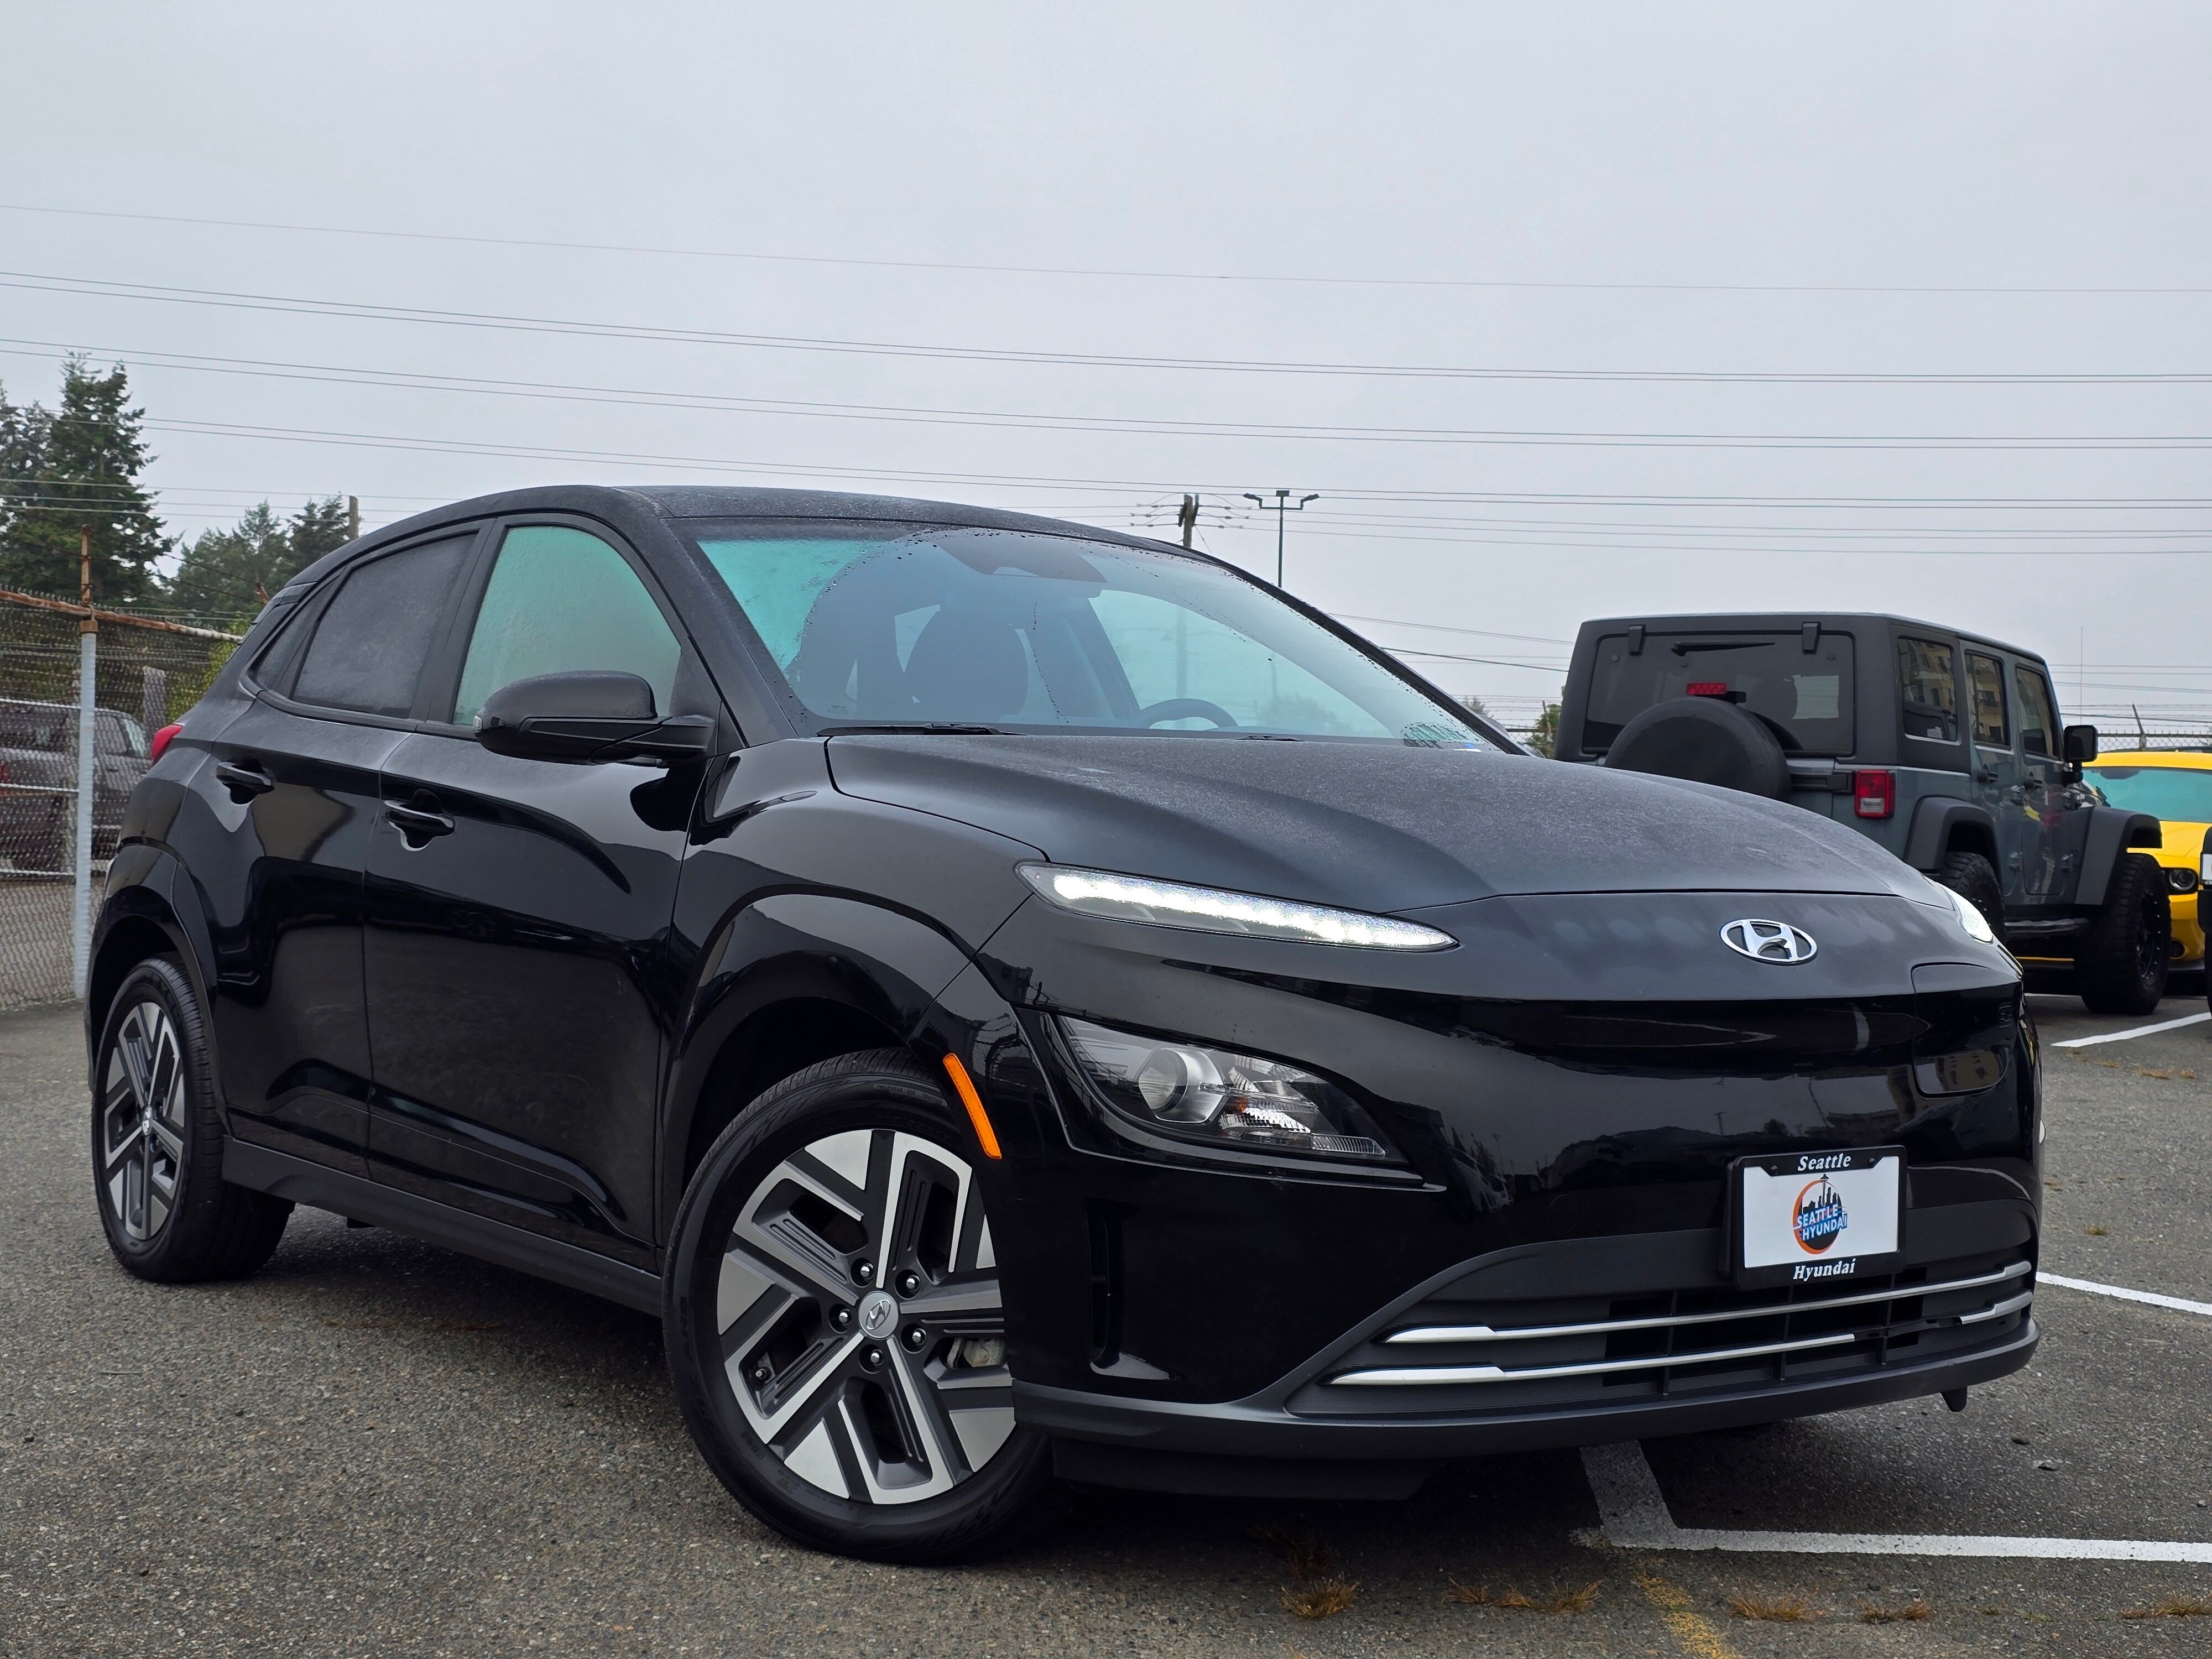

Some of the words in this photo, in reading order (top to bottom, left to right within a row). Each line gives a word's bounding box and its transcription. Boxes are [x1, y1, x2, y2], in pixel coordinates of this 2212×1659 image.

[1797, 1154, 1851, 1171] Seattle
[1796, 1204, 1838, 1229] SEATTLE
[1802, 1213, 1848, 1241] HYUNDAI
[1793, 1259, 1856, 1282] Hyundai
